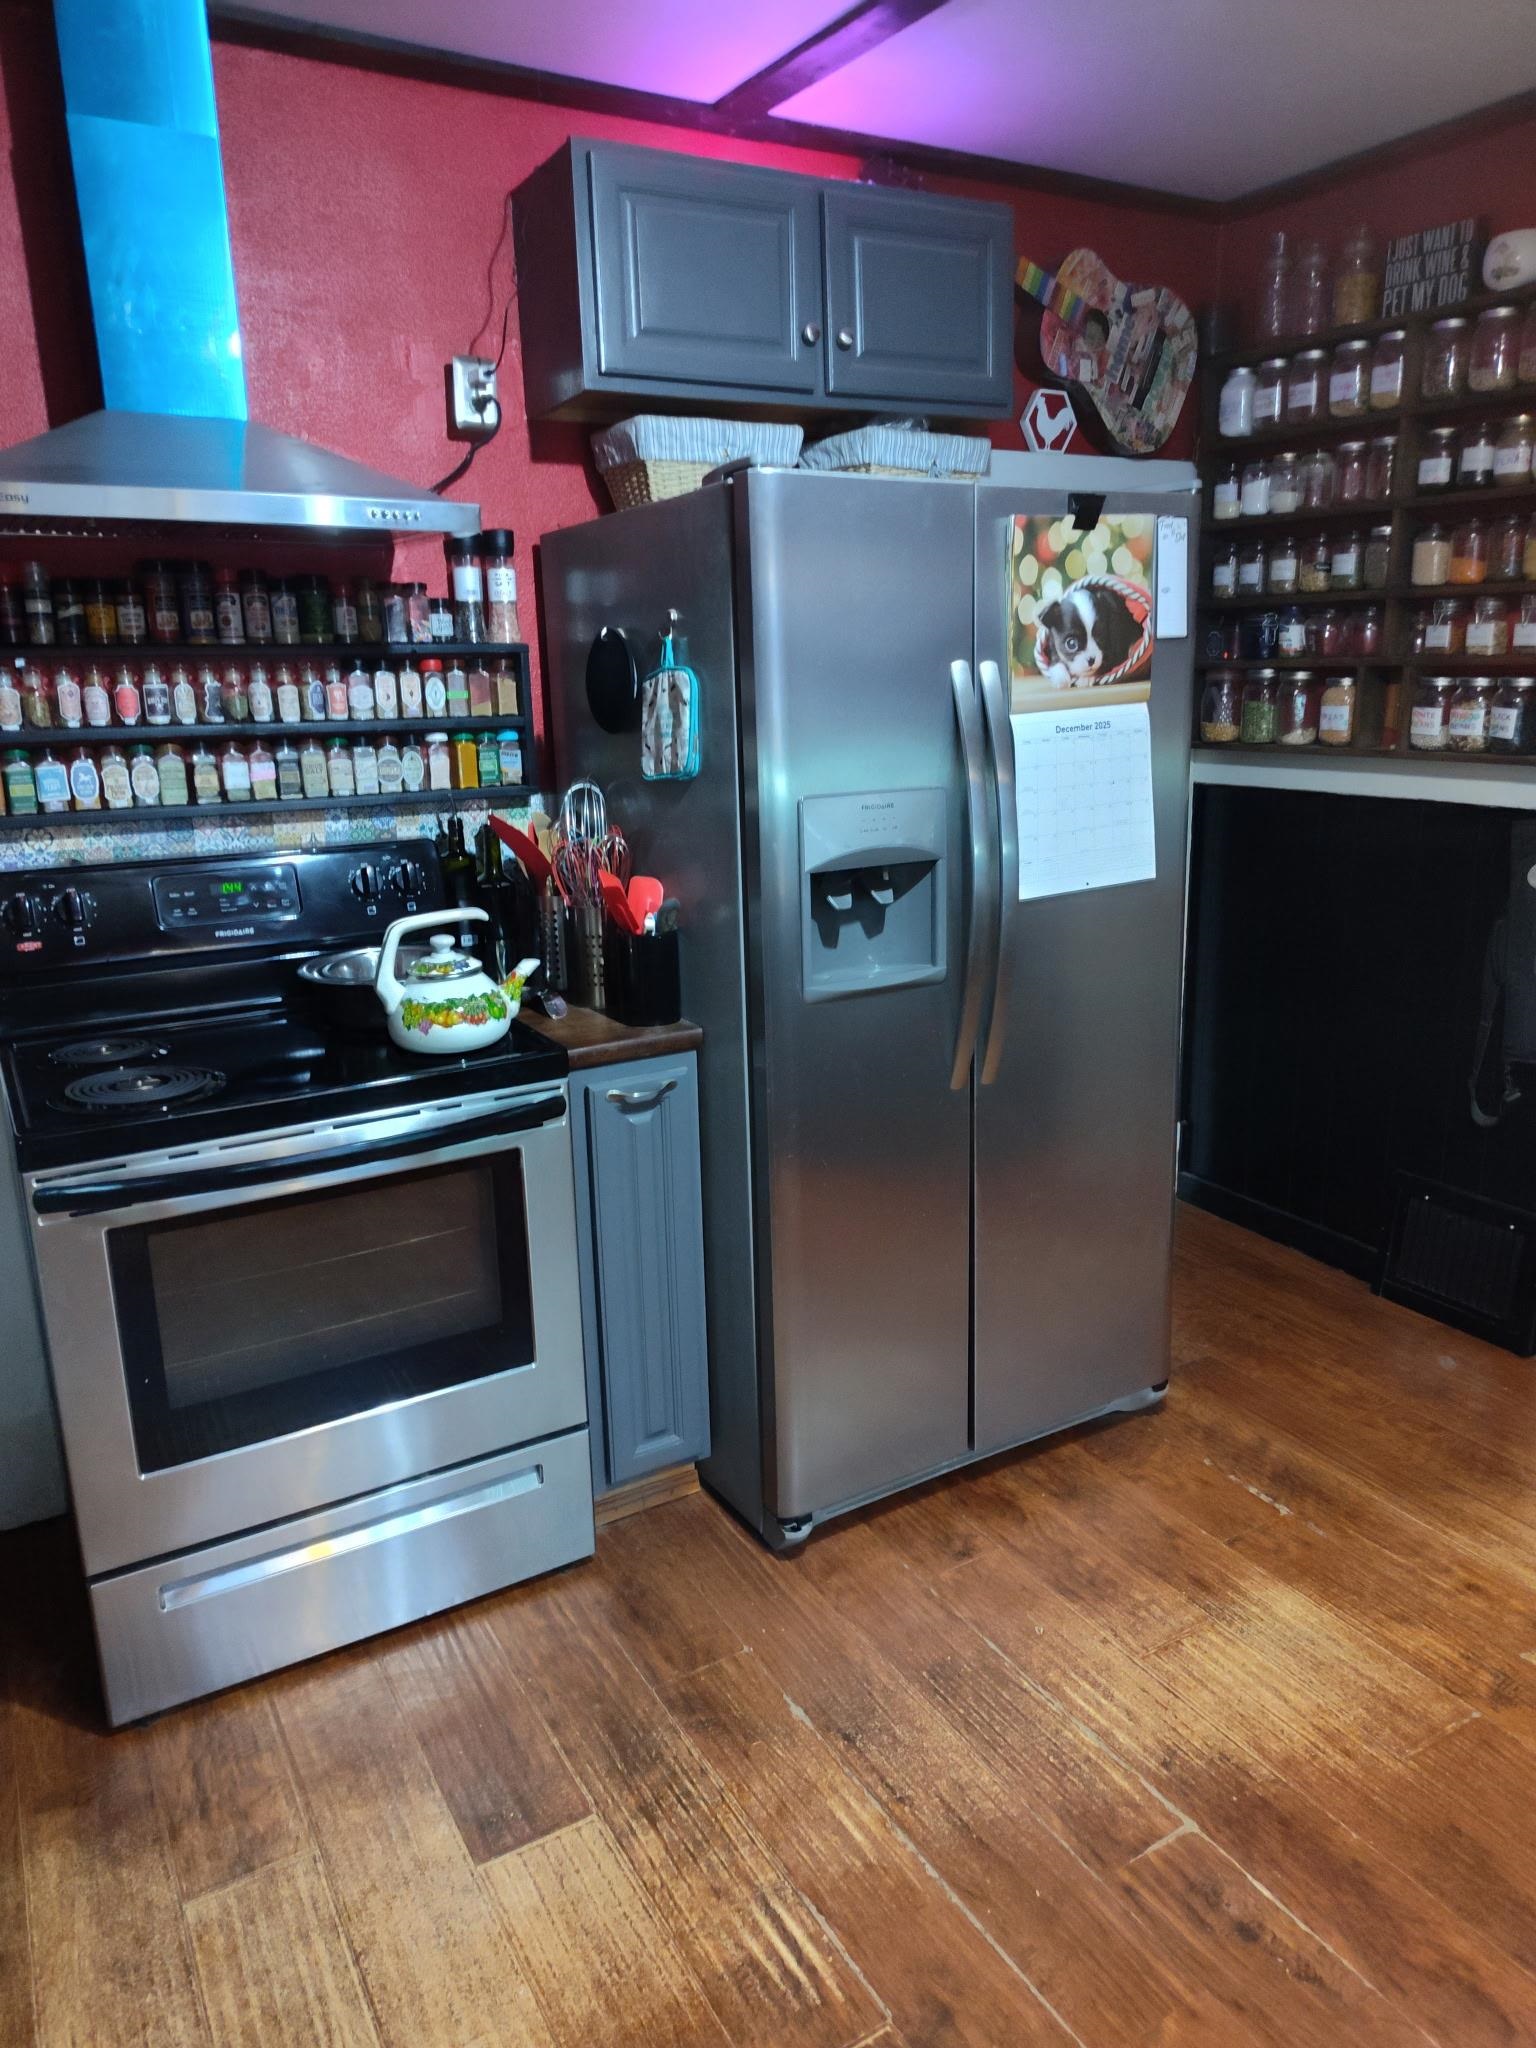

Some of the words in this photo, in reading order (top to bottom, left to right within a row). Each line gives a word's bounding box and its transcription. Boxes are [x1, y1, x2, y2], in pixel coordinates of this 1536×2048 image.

[1393, 232, 1421, 262] JUST
[1423, 222, 1457, 253] WANT
[1458, 219, 1474, 245] TO
[1385, 255, 1422, 288] DRINK
[1425, 246, 1459, 279] WINE
[1461, 244, 1470, 270] &
[1382, 285, 1409, 318] PET
[1411, 279, 1435, 312] MY
[1437, 272, 1469, 307] DOG
[1055, 723, 1093, 734] December
[1094, 720, 1111, 730] 2025
[861, 802, 895, 811] FRIGIDAIRE
[214, 926, 255, 938] FRIGIDAIRE
